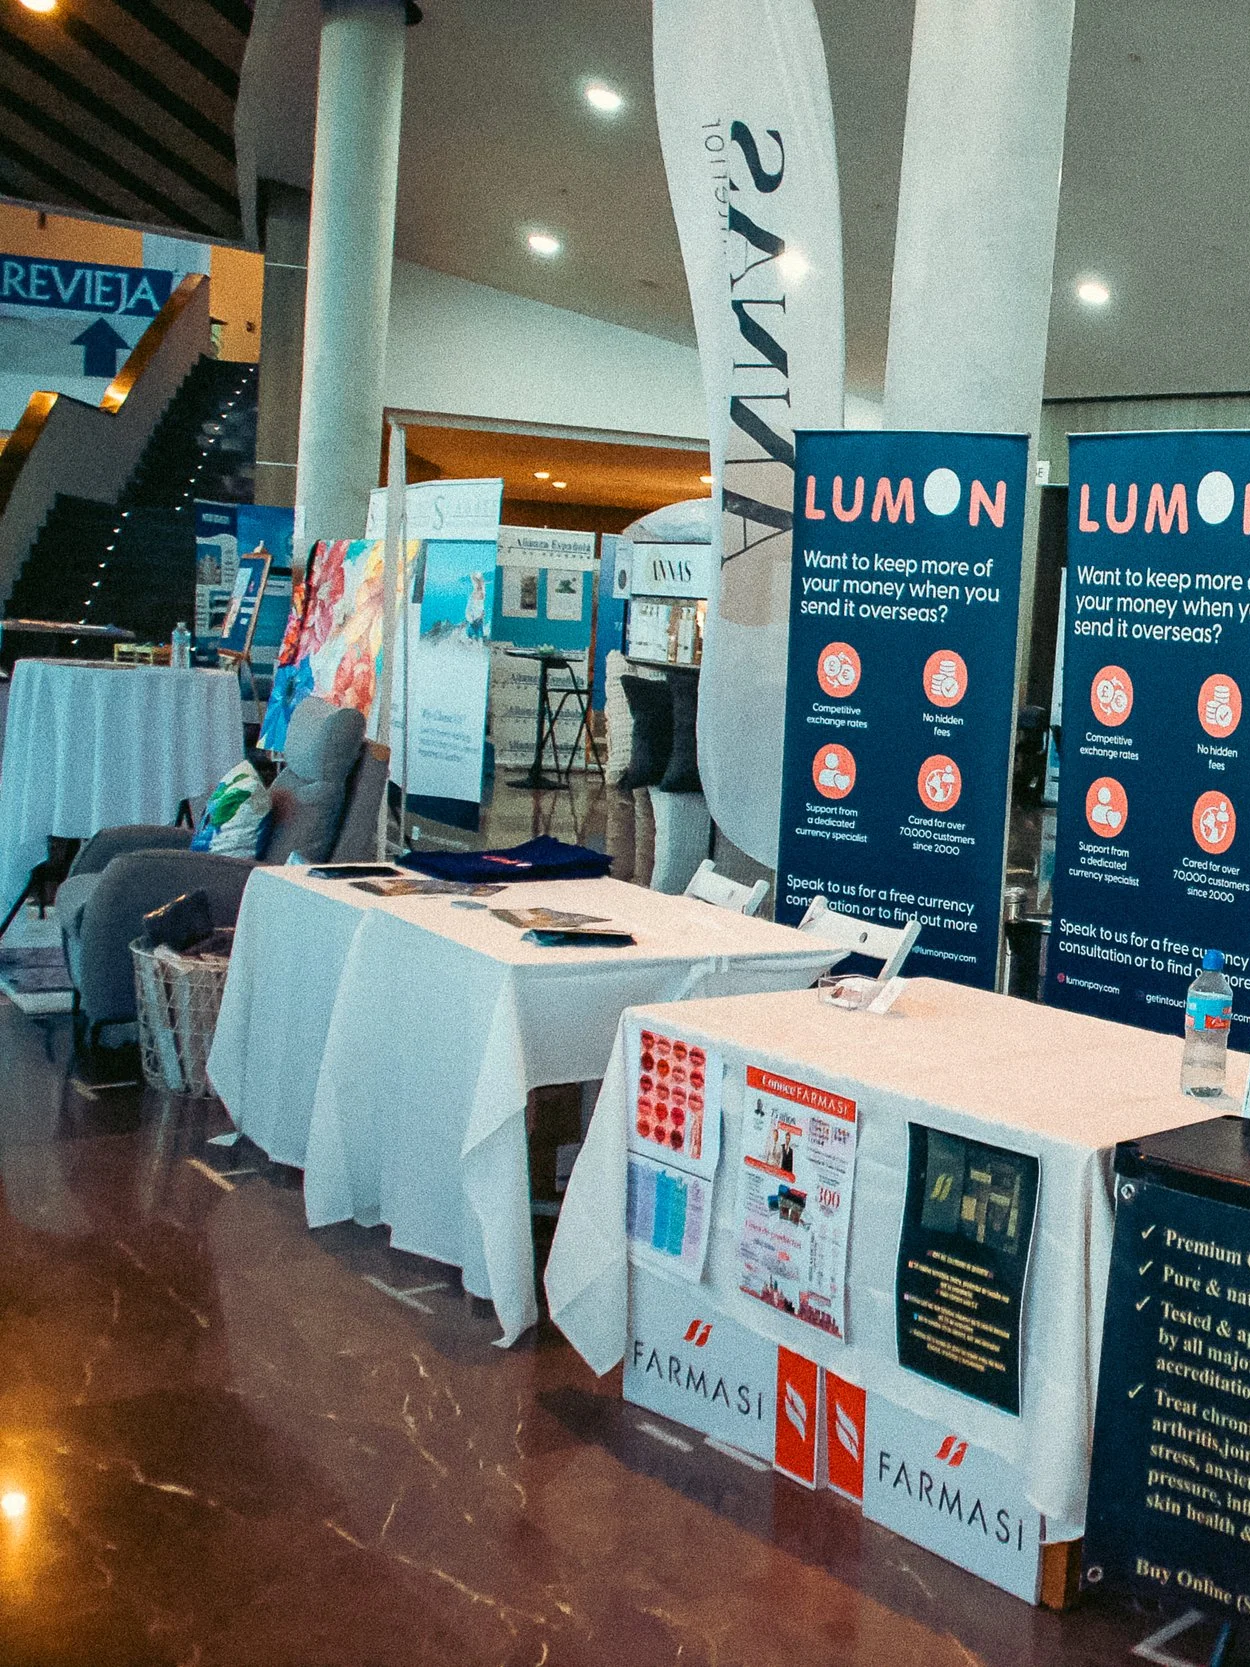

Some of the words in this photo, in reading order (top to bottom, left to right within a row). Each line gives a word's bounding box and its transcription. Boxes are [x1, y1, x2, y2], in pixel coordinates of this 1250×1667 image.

[1, 261, 160, 314] REVIEJA
[805, 468, 1006, 528] LUMON
[804, 550, 847, 570] Want
[852, 553, 870, 572] to
[874, 554, 918, 581] keep
[922, 560, 968, 576] more
[973, 559, 994, 577] of
[802, 577, 839, 594] your
[843, 579, 904, 600] money
[909, 581, 960, 600] when
[965, 586, 1000, 604] you
[1077, 566, 1121, 586] Want
[1126, 570, 1142, 587] to
[1147, 568, 1190, 593] keep
[1195, 574, 1242, 591] more
[800, 599, 840, 616] send
[844, 599, 854, 617] it
[859, 604, 948, 622] overseas?
[1076, 594, 1113, 614] your
[1117, 597, 1178, 618] money
[1182, 597, 1234, 618] when
[1074, 618, 1113, 638] send
[1118, 618, 1128, 638] it
[1132, 624, 1222, 644] overseas?
[806, 714, 845, 728] exchange
[846, 718, 868, 729] rates
[812, 702, 861, 717] Competitive
[923, 712, 934, 724] No
[935, 714, 964, 726] hidden
[934, 726, 950, 737] fees
[1086, 732, 1133, 746] Competitive
[1080, 746, 1118, 760] exchange
[1119, 749, 1139, 761] rates
[1197, 744, 1208, 755] No
[1209, 746, 1238, 758] hidden
[1208, 759, 1226, 771] fees
[806, 802, 838, 817] Support
[838, 806, 858, 817] from
[796, 826, 830, 840] currency
[832, 828, 868, 843] specialist
[814, 816, 855, 830] dedicated
[908, 816, 933, 828] Cared
[934, 818, 946, 828] for
[946, 822, 966, 831] over
[900, 826, 932, 840] 70,000
[933, 832, 976, 845] customers
[913, 841, 932, 852] since
[934, 844, 960, 856] 2000
[1078, 841, 1110, 857] Support
[1110, 845, 1130, 858] from
[1088, 856, 1127, 870] dedicated
[1182, 856, 1208, 870] Cared
[1209, 861, 1221, 872] for
[1222, 866, 1240, 876] over
[1068, 868, 1103, 882] currency
[1104, 872, 1140, 887] specialist
[1173, 869, 1206, 884] 70,000
[1208, 877, 1250, 892] customers
[787, 874, 824, 896] Speak
[828, 880, 840, 894] to
[843, 884, 856, 896] us
[858, 884, 876, 900] for
[890, 888, 915, 904] free
[918, 894, 976, 916] currency
[1187, 886, 1208, 898] since
[1208, 890, 1234, 903] 2000
[786, 894, 860, 916] consation
[863, 906, 876, 917] or
[878, 905, 892, 920] to
[894, 908, 918, 923] find
[920, 912, 941, 928] out
[944, 918, 978, 933] more
[1060, 918, 1097, 940] Speak
[1100, 926, 1112, 941] to
[1115, 932, 1128, 944] us
[1130, 932, 1148, 948] for
[1163, 938, 1189, 956] free
[1192, 947, 1250, 971] cuncy
[1059, 940, 1132, 967] consultation
[1134, 957, 1148, 969] or
[1151, 956, 1164, 972] to
[1167, 959, 1192, 978] find
[1066, 975, 1120, 996] lumonpay.com
[796, 1087, 848, 1116] FARMASI
[1165, 1227, 1242, 1266] Premium
[1163, 1264, 1201, 1292] Pure
[1206, 1279, 1221, 1298] &
[1161, 1300, 1212, 1332] Tested
[1216, 1320, 1232, 1338] &
[1158, 1327, 1178, 1350] by
[1183, 1332, 1204, 1356] all
[633, 1340, 763, 1421] FARMASI
[1154, 1387, 1198, 1418] Treat
[1150, 1444, 1200, 1472] stress,
[1148, 1468, 1222, 1507] pressure,
[880, 1451, 1023, 1552] FARMASI
[1146, 1494, 1182, 1516] skin
[1187, 1504, 1236, 1537] health
[1136, 1558, 1171, 1585] Buy
[1177, 1569, 1232, 1604] Online
